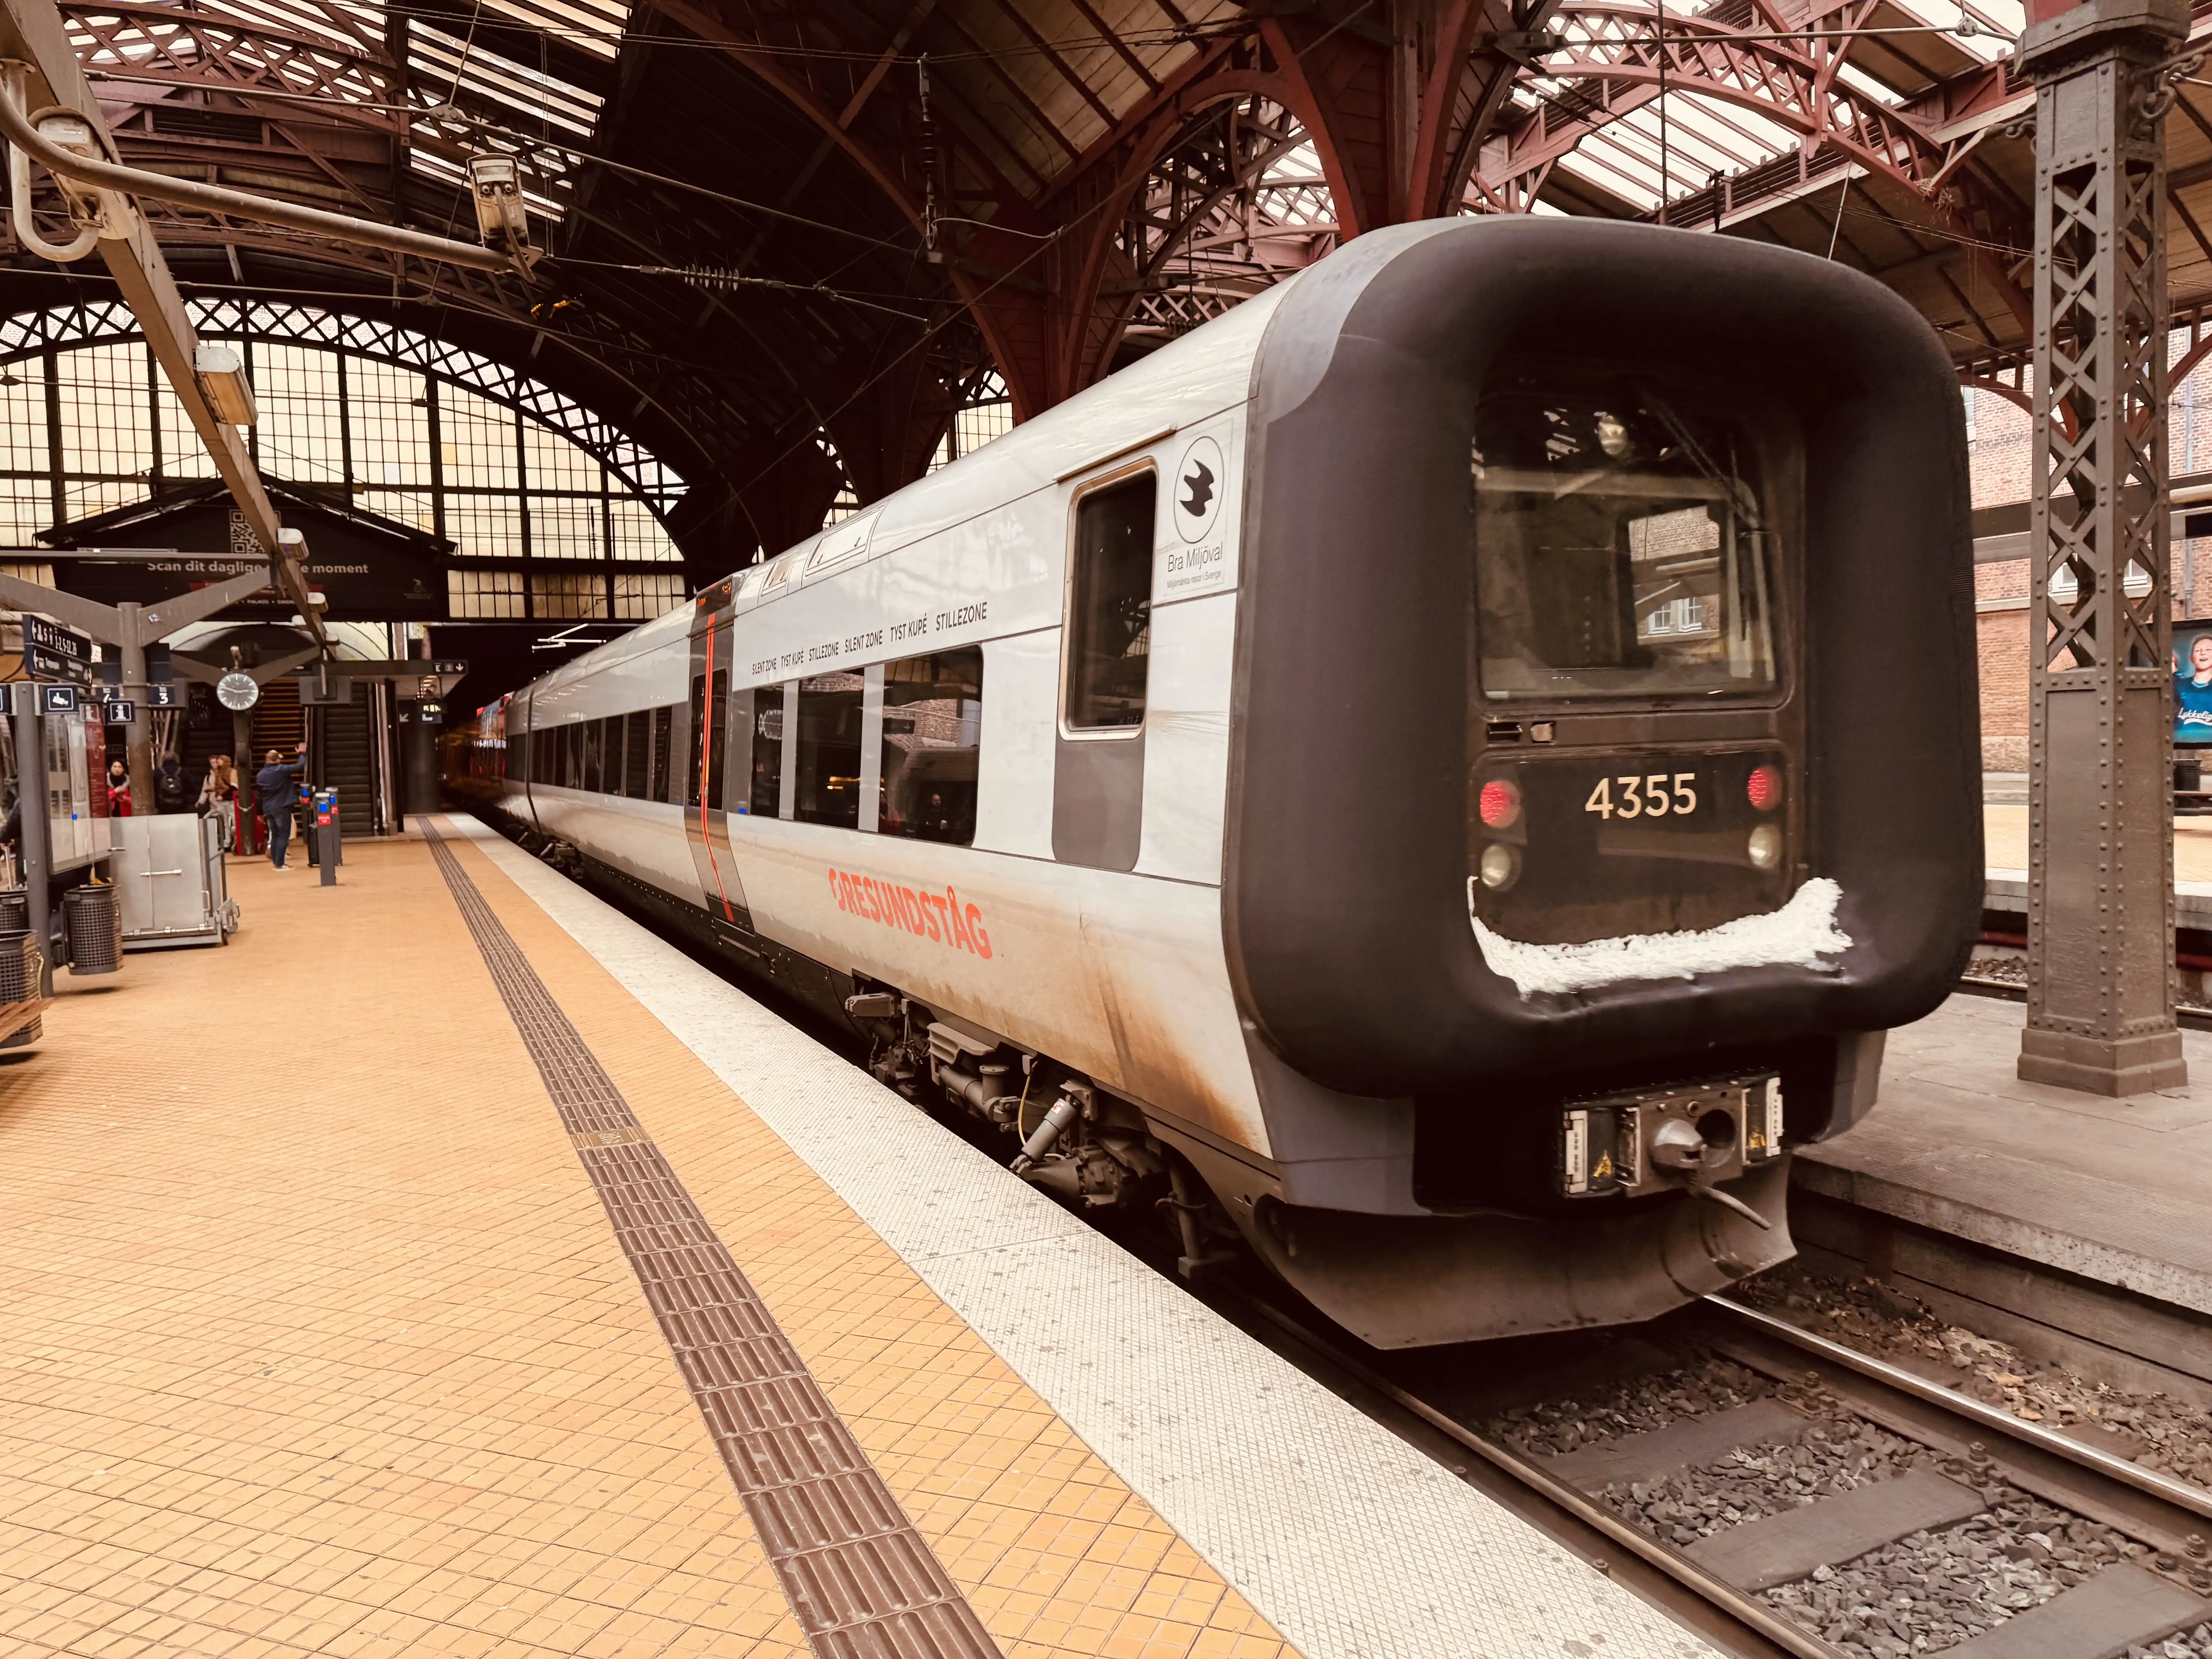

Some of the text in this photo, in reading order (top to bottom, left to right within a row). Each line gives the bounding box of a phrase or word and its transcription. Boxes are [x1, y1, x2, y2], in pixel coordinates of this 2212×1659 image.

[148, 562, 181, 571] Scan
[185, 560, 205, 572] dit
[313, 564, 369, 574] moment
[1168, 541, 1223, 572] Bra Miljöval
[752, 601, 987, 675] SILENT ZONE TYST KUPÉ STILLEZONE SILENT ZONE TYST KUPÉ STILLEZONE
[159, 692, 168, 704] 3
[1585, 773, 1697, 819] 4355
